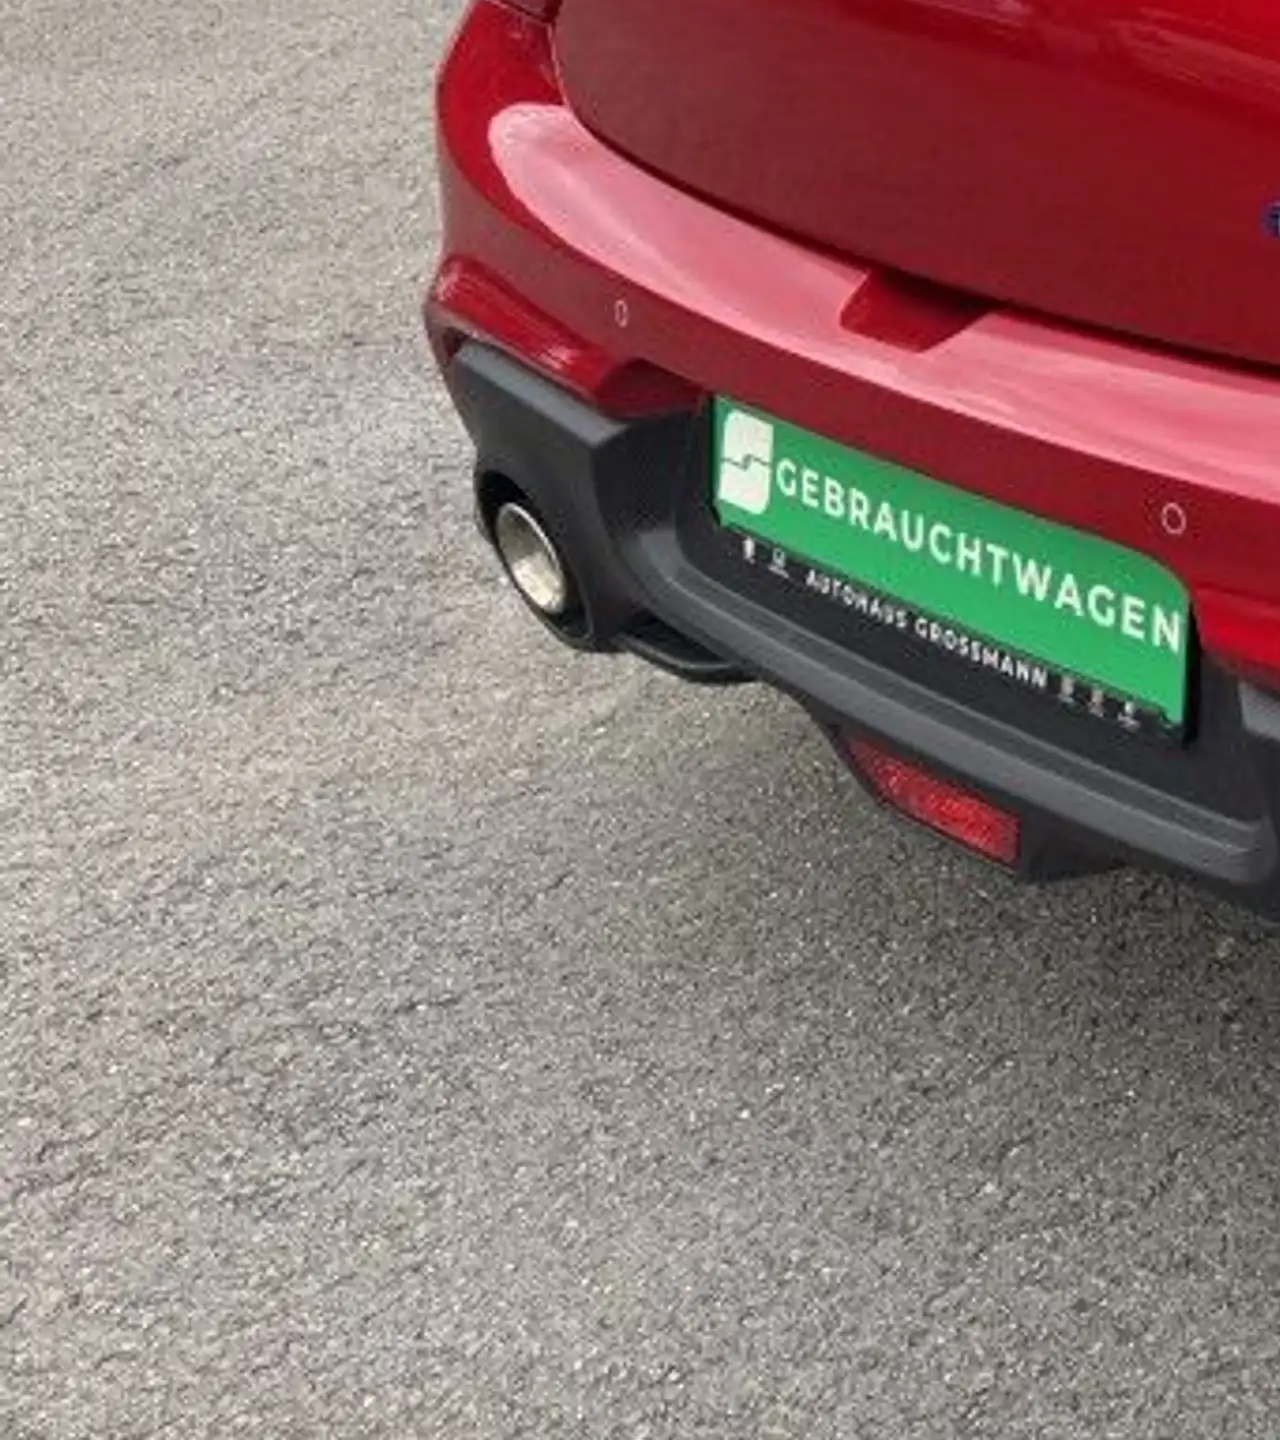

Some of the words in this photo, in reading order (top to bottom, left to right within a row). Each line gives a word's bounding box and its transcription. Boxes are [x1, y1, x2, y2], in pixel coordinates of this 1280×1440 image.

[775, 457, 1181, 653] GEBRAUCHTWAGEN
[806, 570, 908, 628] AUTOHAUS
[914, 617, 1048, 689] GROSSMANN
